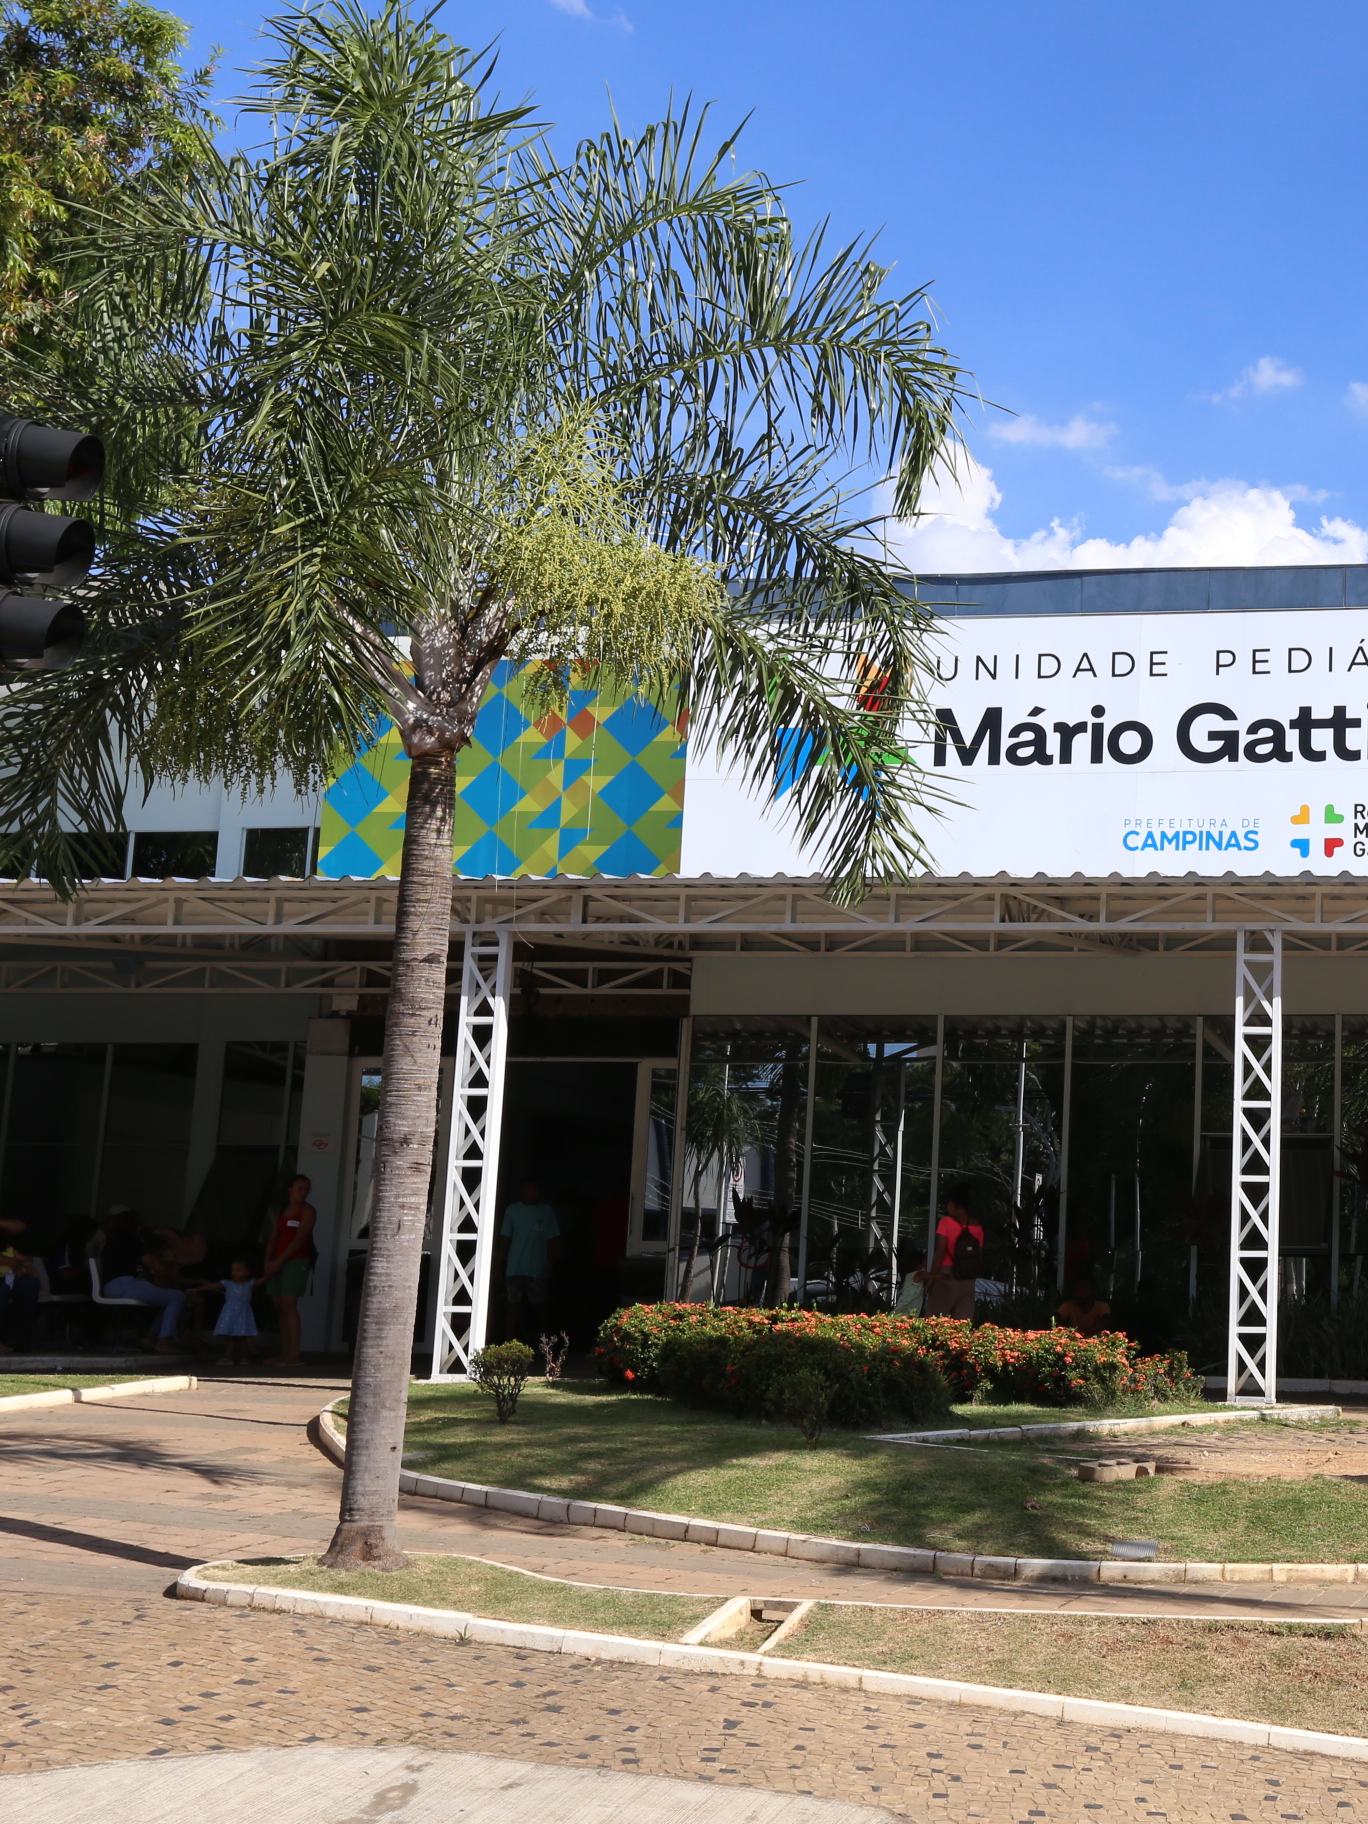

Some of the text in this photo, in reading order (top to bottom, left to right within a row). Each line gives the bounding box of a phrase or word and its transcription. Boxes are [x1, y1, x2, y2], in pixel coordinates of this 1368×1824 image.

[937, 650, 1168, 682] UNIDADE
[933, 704, 1154, 767] Mário
[1123, 818, 1260, 829] PREFEITURA DE
[1122, 830, 1260, 852] CAMPINAS
